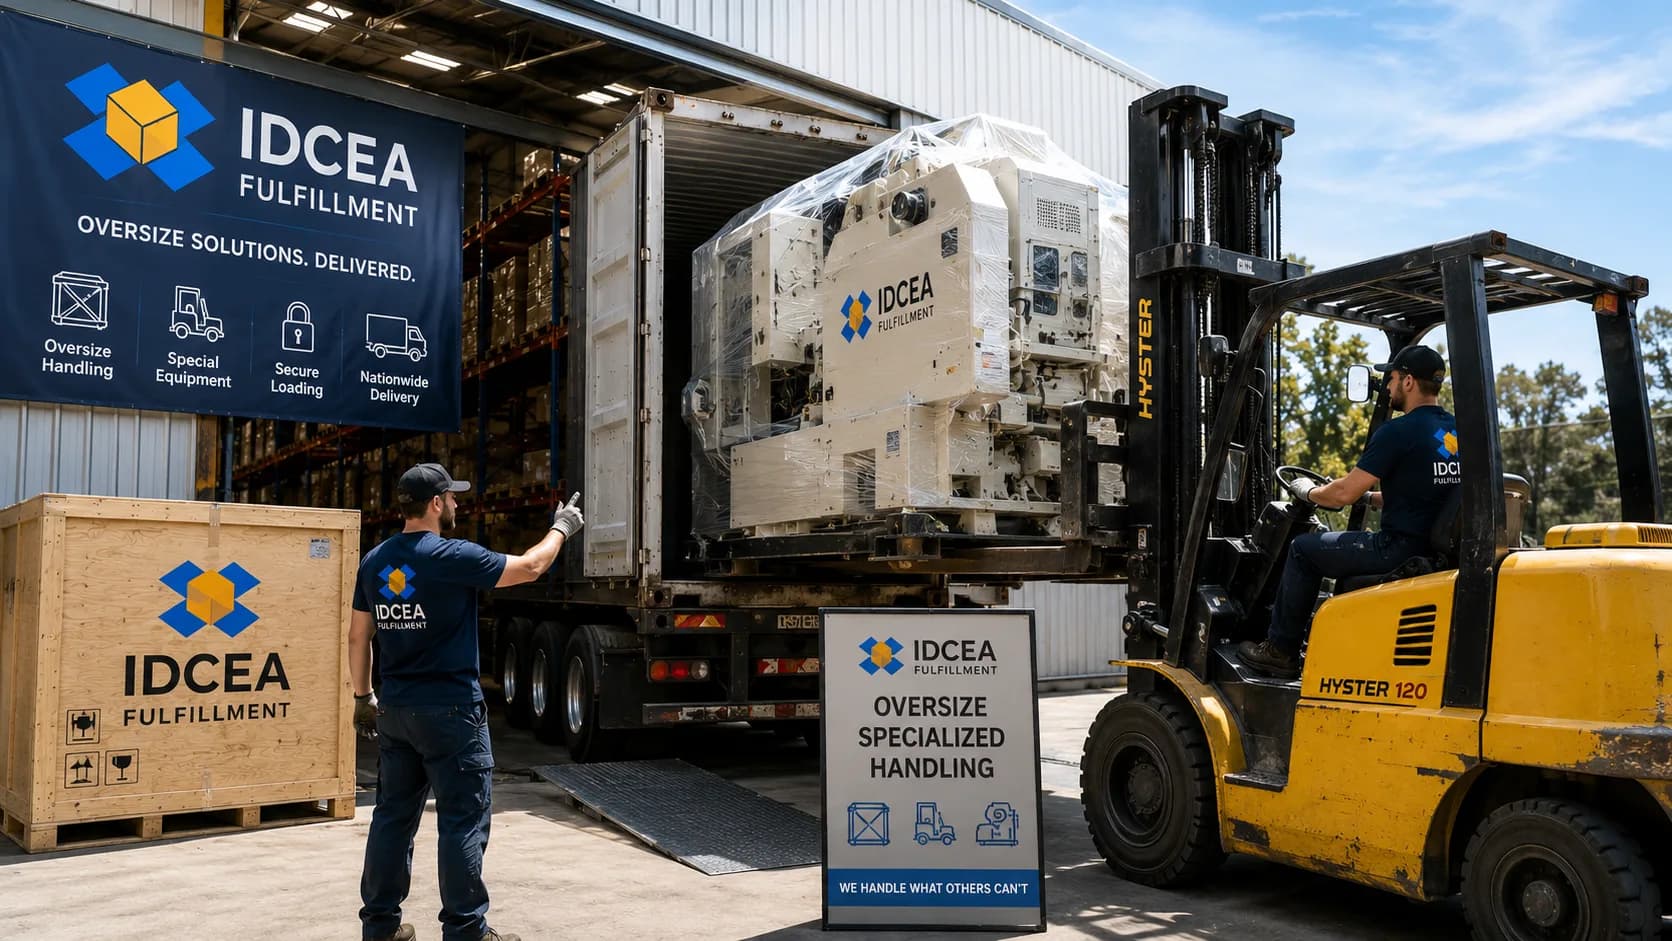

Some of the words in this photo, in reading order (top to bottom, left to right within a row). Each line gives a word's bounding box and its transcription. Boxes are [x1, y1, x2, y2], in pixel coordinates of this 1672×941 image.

[240, 107, 418, 192] IDCEA
[239, 174, 418, 227] FULFILLMENT
[77, 215, 184, 248] OVERSIZE
[191, 233, 309, 267] SOLUTIONS.
[315, 252, 416, 282] DELIVERED.
[878, 272, 934, 315] IDCEA
[878, 305, 934, 333] FULFILLMENT
[44, 338, 112, 358] Oversize
[1138, 297, 1152, 420] HYSTER
[41, 357, 113, 380] Handling
[167, 351, 219, 372] Special
[275, 362, 319, 378] Secure
[155, 369, 231, 389] Equipment
[271, 380, 323, 399] Loading
[360, 371, 429, 389] Nationwide
[370, 389, 419, 407] Delivery
[1433, 462, 1460, 476] IDC
[375, 604, 426, 620] IDCEA
[377, 621, 427, 630] FULFILLMENT
[913, 640, 997, 661] IDCEA
[124, 652, 291, 696] IDCEA
[914, 665, 997, 675] FULFILLMENT
[1319, 677, 1390, 697] HYSTER
[1395, 682, 1428, 699] 120
[123, 702, 291, 727] FULFILLMENT
[874, 696, 987, 717] OVERSIZE
[858, 727, 1005, 748] SPECIALIZED
[870, 757, 994, 779] HANDLING
[839, 882, 858, 893] WE
[860, 882, 906, 894] HANDLE
[909, 882, 943, 894] WHAT
[945, 883, 991, 894] OTHERS
[994, 883, 1028, 895] CAN'T
